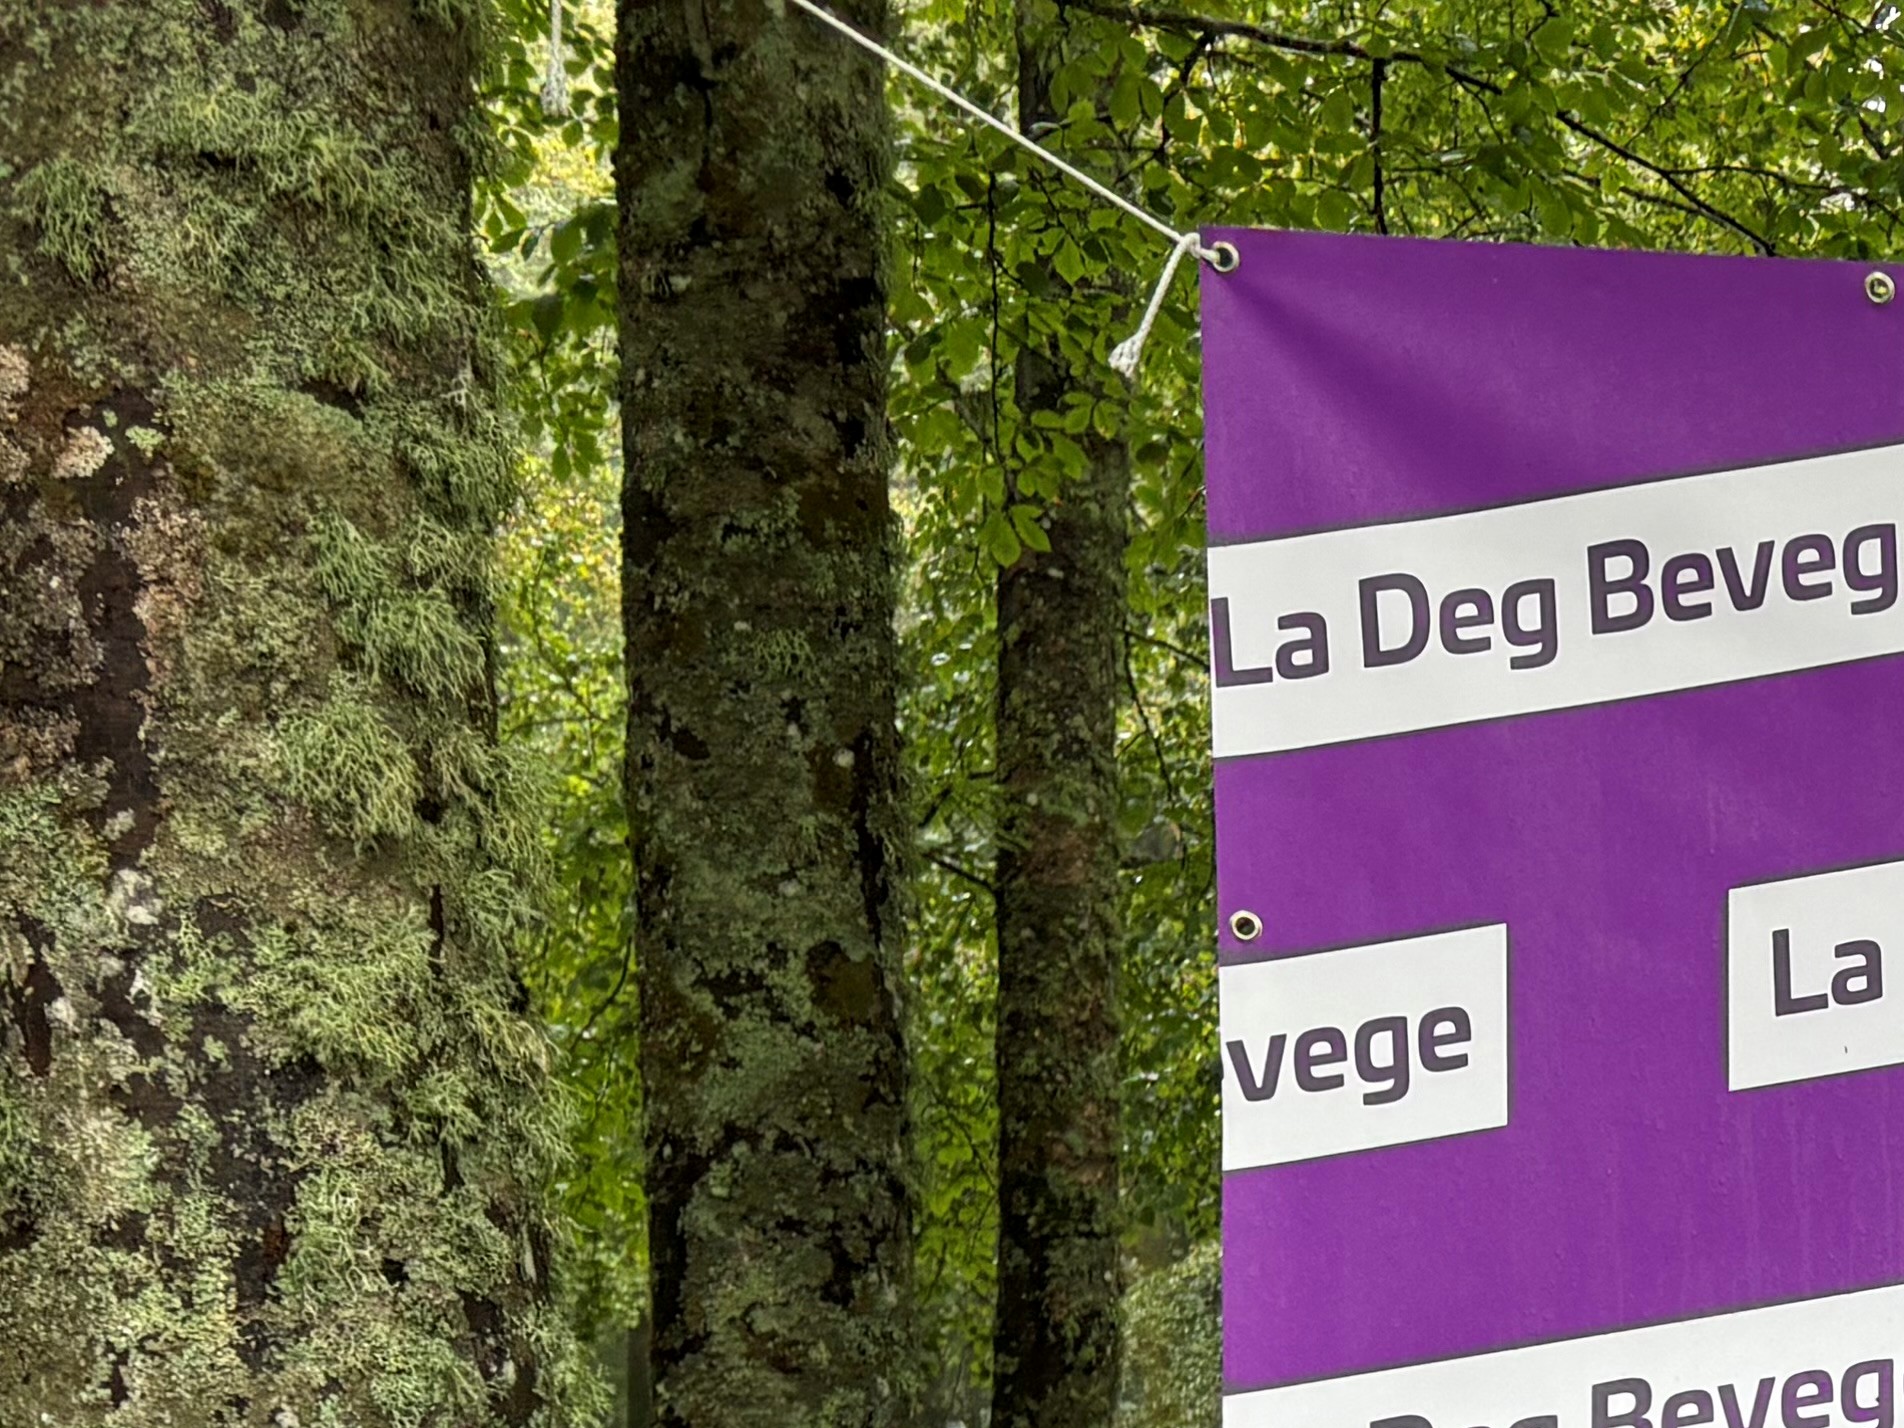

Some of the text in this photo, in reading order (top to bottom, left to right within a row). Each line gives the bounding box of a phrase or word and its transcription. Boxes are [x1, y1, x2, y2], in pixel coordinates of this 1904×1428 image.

[1210, 597, 1329, 687] La
[1359, 573, 1557, 669] Deg
[1773, 929, 1882, 1016] La
